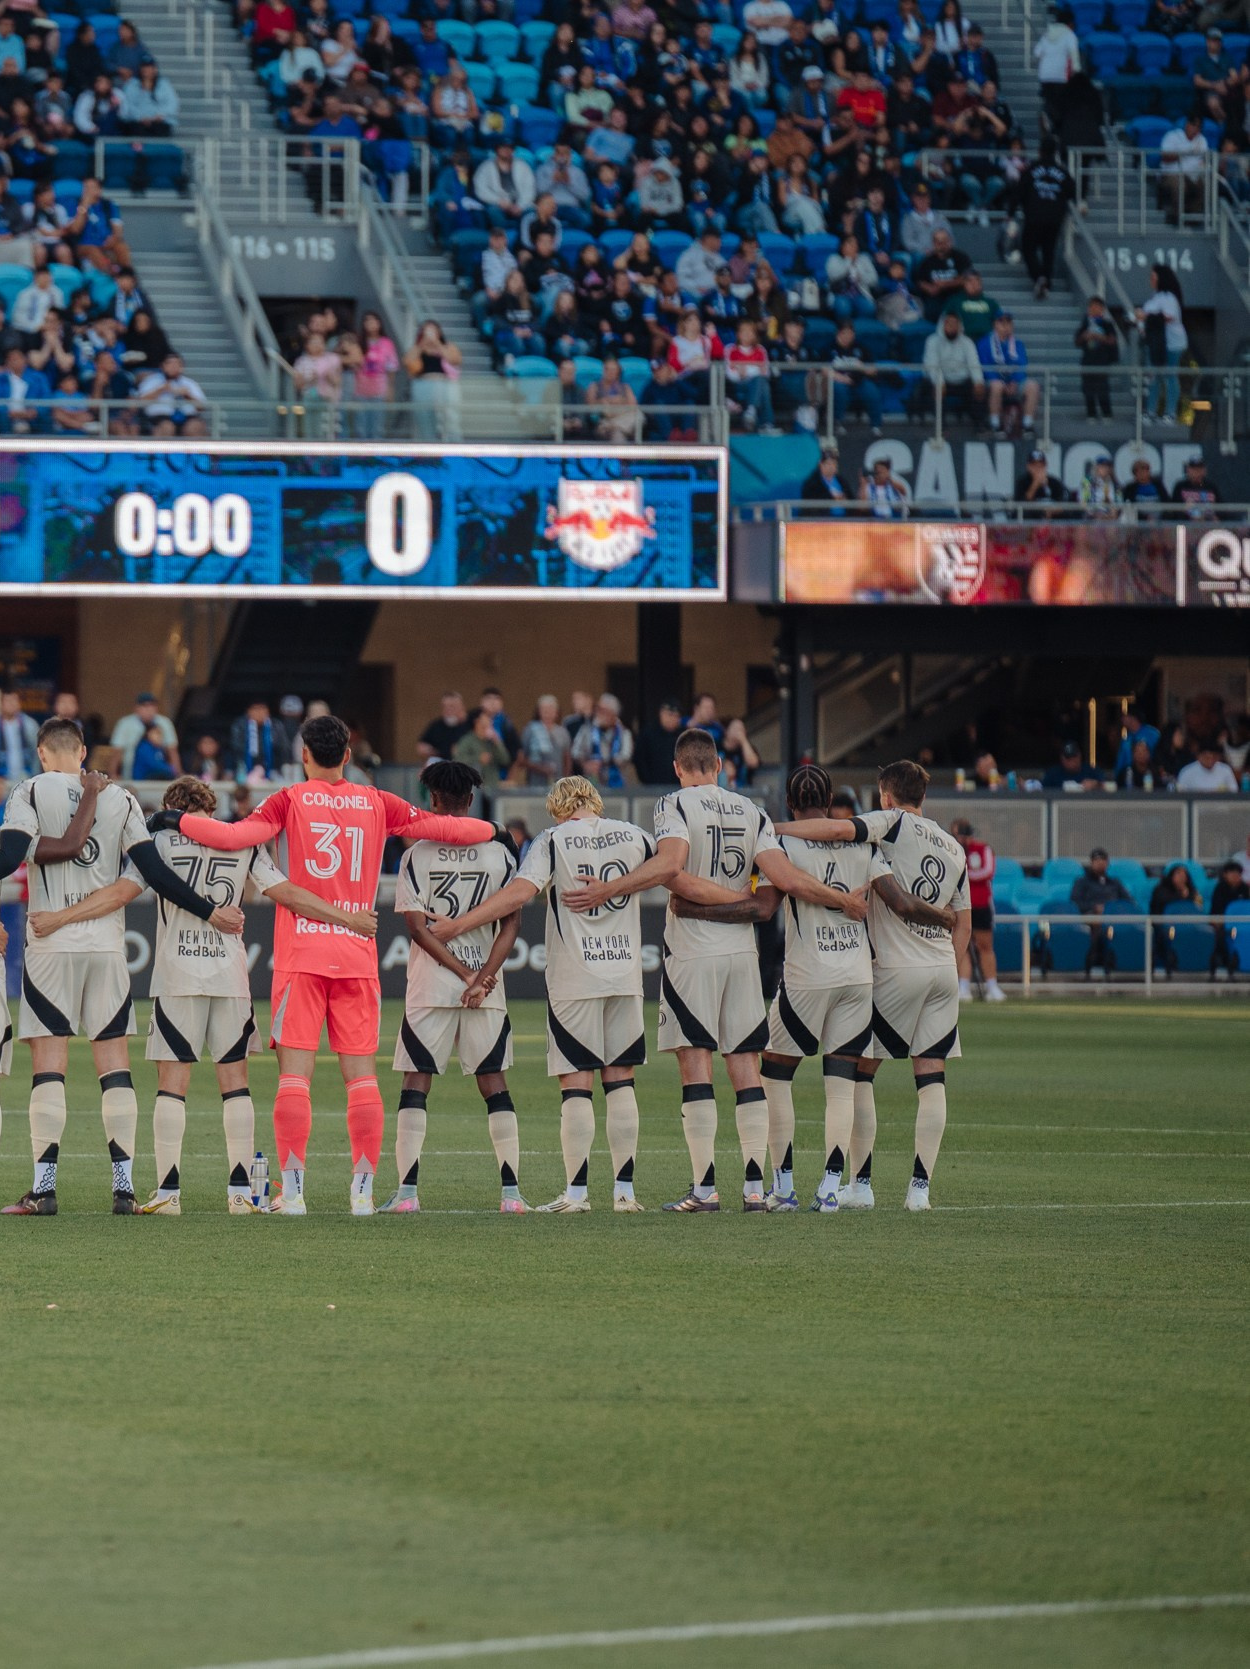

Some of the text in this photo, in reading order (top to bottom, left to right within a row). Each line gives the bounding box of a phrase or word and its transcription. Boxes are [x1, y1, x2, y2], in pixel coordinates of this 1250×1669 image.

[293, 237, 336, 262] 115
[115, 492, 251, 558] 0:00
[365, 471, 433, 577] 0
[302, 792, 373, 810] CORONEL
[304, 821, 364, 882] 31
[438, 847, 479, 863] SOFO
[564, 830, 634, 850] FORSBERG
[706, 824, 746, 880] 15
[914, 823, 958, 856] STROUD
[171, 855, 240, 909] 75
[427, 870, 490, 922] 37
[578, 858, 631, 916] 10
[911, 854, 946, 905] 8
[179, 929, 200, 944] NEW
[582, 934, 630, 950] NEW YORK
[816, 926, 835, 941] NEW
